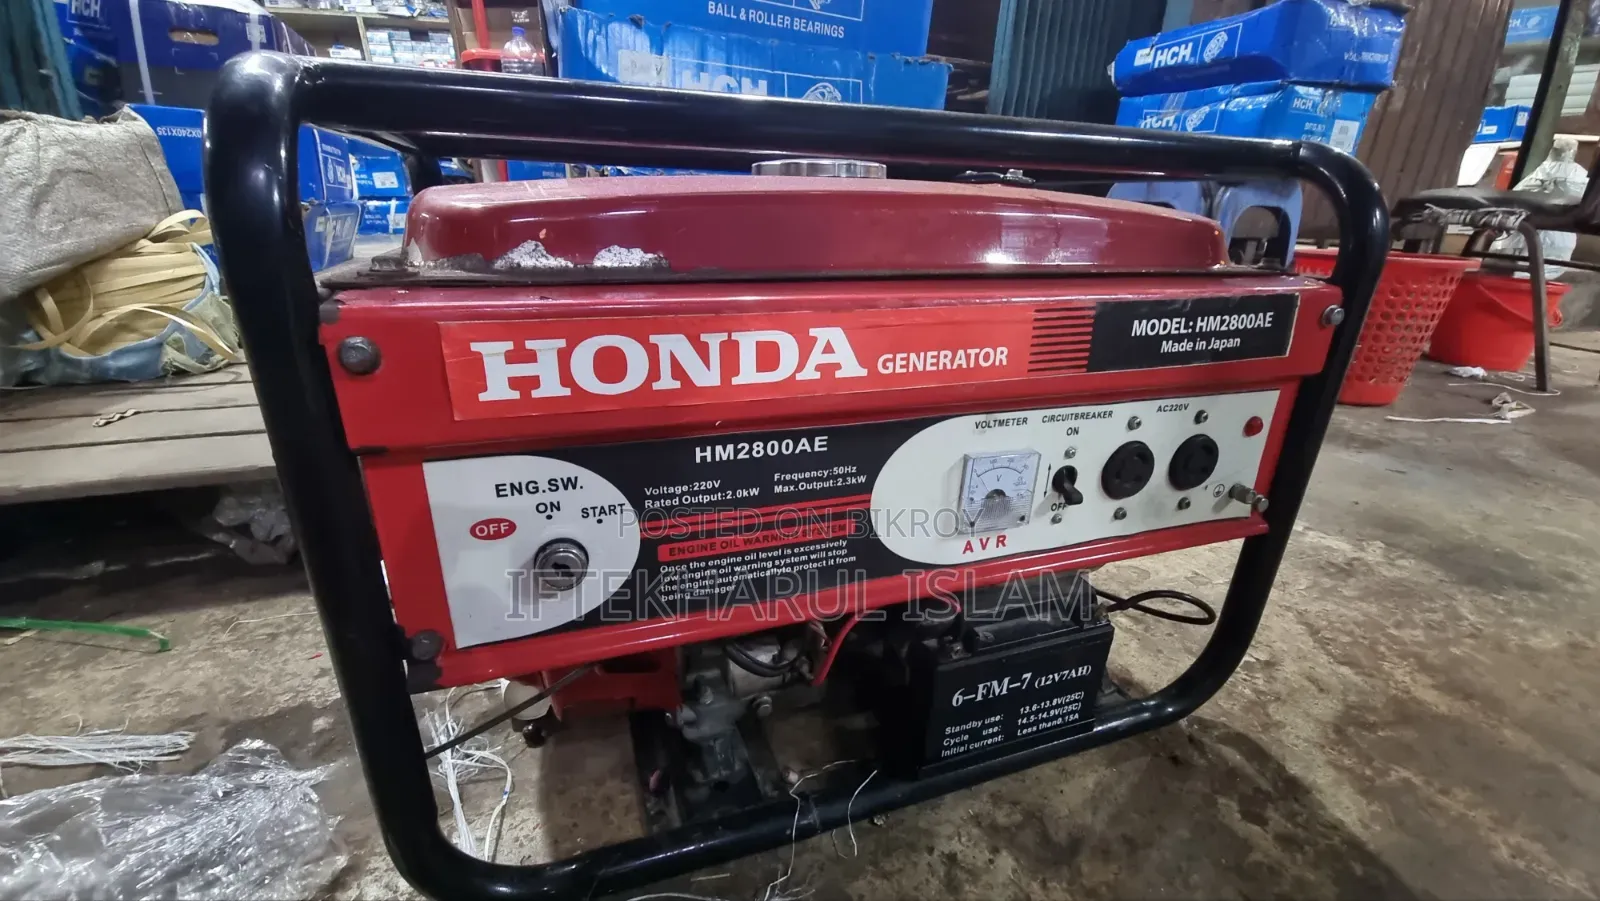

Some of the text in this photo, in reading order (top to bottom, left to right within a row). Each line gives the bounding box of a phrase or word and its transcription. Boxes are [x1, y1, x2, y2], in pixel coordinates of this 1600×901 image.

[708, 1, 845, 39] BALL & ROLLER BEARINGS
[1154, 42, 1193, 69] HCH
[1293, 98, 1313, 109] HCH
[1131, 311, 1274, 338] MODEL: HM2800AE
[1160, 336, 1240, 353] Made in Japan
[470, 327, 1008, 402] HONDA GENERATOR
[1042, 410, 1113, 424] CIRCUITBREAKER
[1156, 403, 1189, 413] AC220V
[975, 417, 1028, 430] VOLTMETER
[1066, 427, 1079, 437] ON
[695, 436, 829, 464] HM2800AE
[774, 465, 857, 482] Frequency:50Hz
[495, 476, 584, 499] ENG.SW.
[644, 480, 721, 496] Voltage:220V
[774, 475, 867, 494] Max.Output:2.3kW
[535, 501, 561, 514] ON
[645, 487, 760, 509] Rated Output:2.0kW
[1051, 503, 1068, 512] OFF
[581, 503, 626, 519] START
[475, 522, 510, 537] OFF
[669, 541, 717, 558] ENGINE
[720, 540, 740, 550] OIL
[743, 530, 798, 546] WARNING
[660, 539, 847, 574] Once the engine oil level is excessively
[682, 569, 717, 580] engine
[719, 566, 732, 575] oil
[734, 559, 773, 572] warning
[774, 555, 808, 568] system
[810, 551, 826, 560] will
[828, 548, 848, 558] stop
[661, 584, 677, 593] the
[680, 579, 714, 589] engine
[793, 560, 826, 573] protect
[828, 557, 835, 566] it
[836, 555, 857, 564] from
[661, 590, 690, 602] being
[952, 664, 1092, 708] 6-FM-7 (12V7AH)
[945, 714, 1004, 735] Standby use:
[1017, 726, 1037, 736] Less
[943, 725, 1001, 746] Cycle use:
[941, 735, 1004, 758] Initial current:
